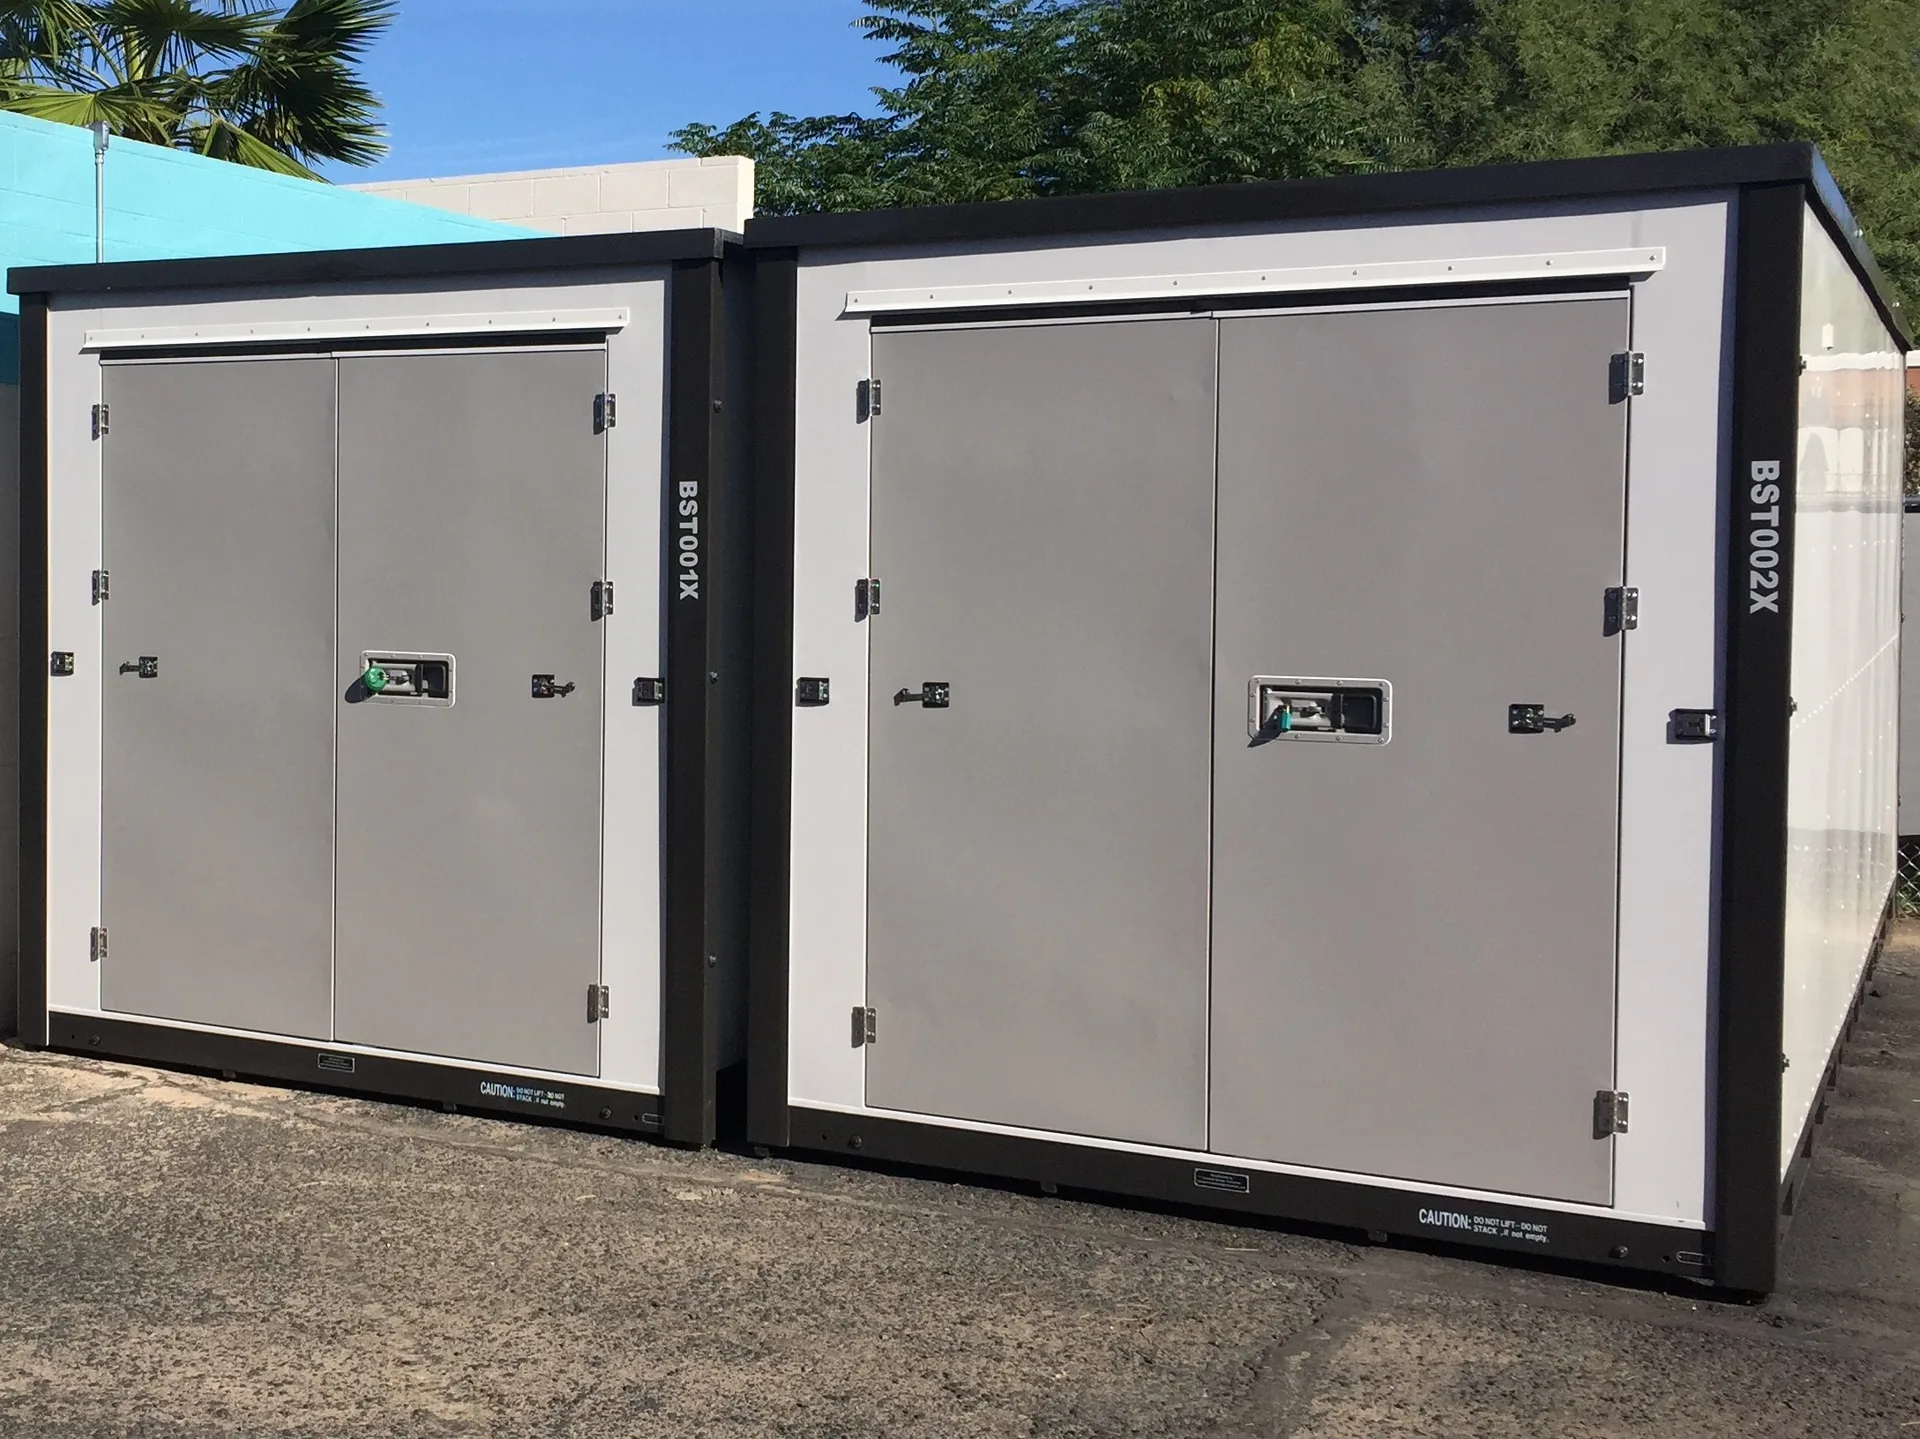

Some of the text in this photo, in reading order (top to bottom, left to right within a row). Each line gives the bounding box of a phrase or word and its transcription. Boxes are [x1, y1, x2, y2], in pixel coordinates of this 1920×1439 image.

[679, 481, 698, 600] BST001X
[1749, 460, 1780, 614] BST002X
[480, 1081, 515, 1098] CAUTION:
[516, 1094, 532, 1103] STACK
[1419, 1208, 1472, 1230] CAUTION:
[1473, 1216, 1484, 1224] DO
[1485, 1217, 1499, 1226] NOT
[1532, 1224, 1548, 1233] NOT
[1473, 1225, 1497, 1235] STACK
[1511, 1231, 1523, 1239] not
